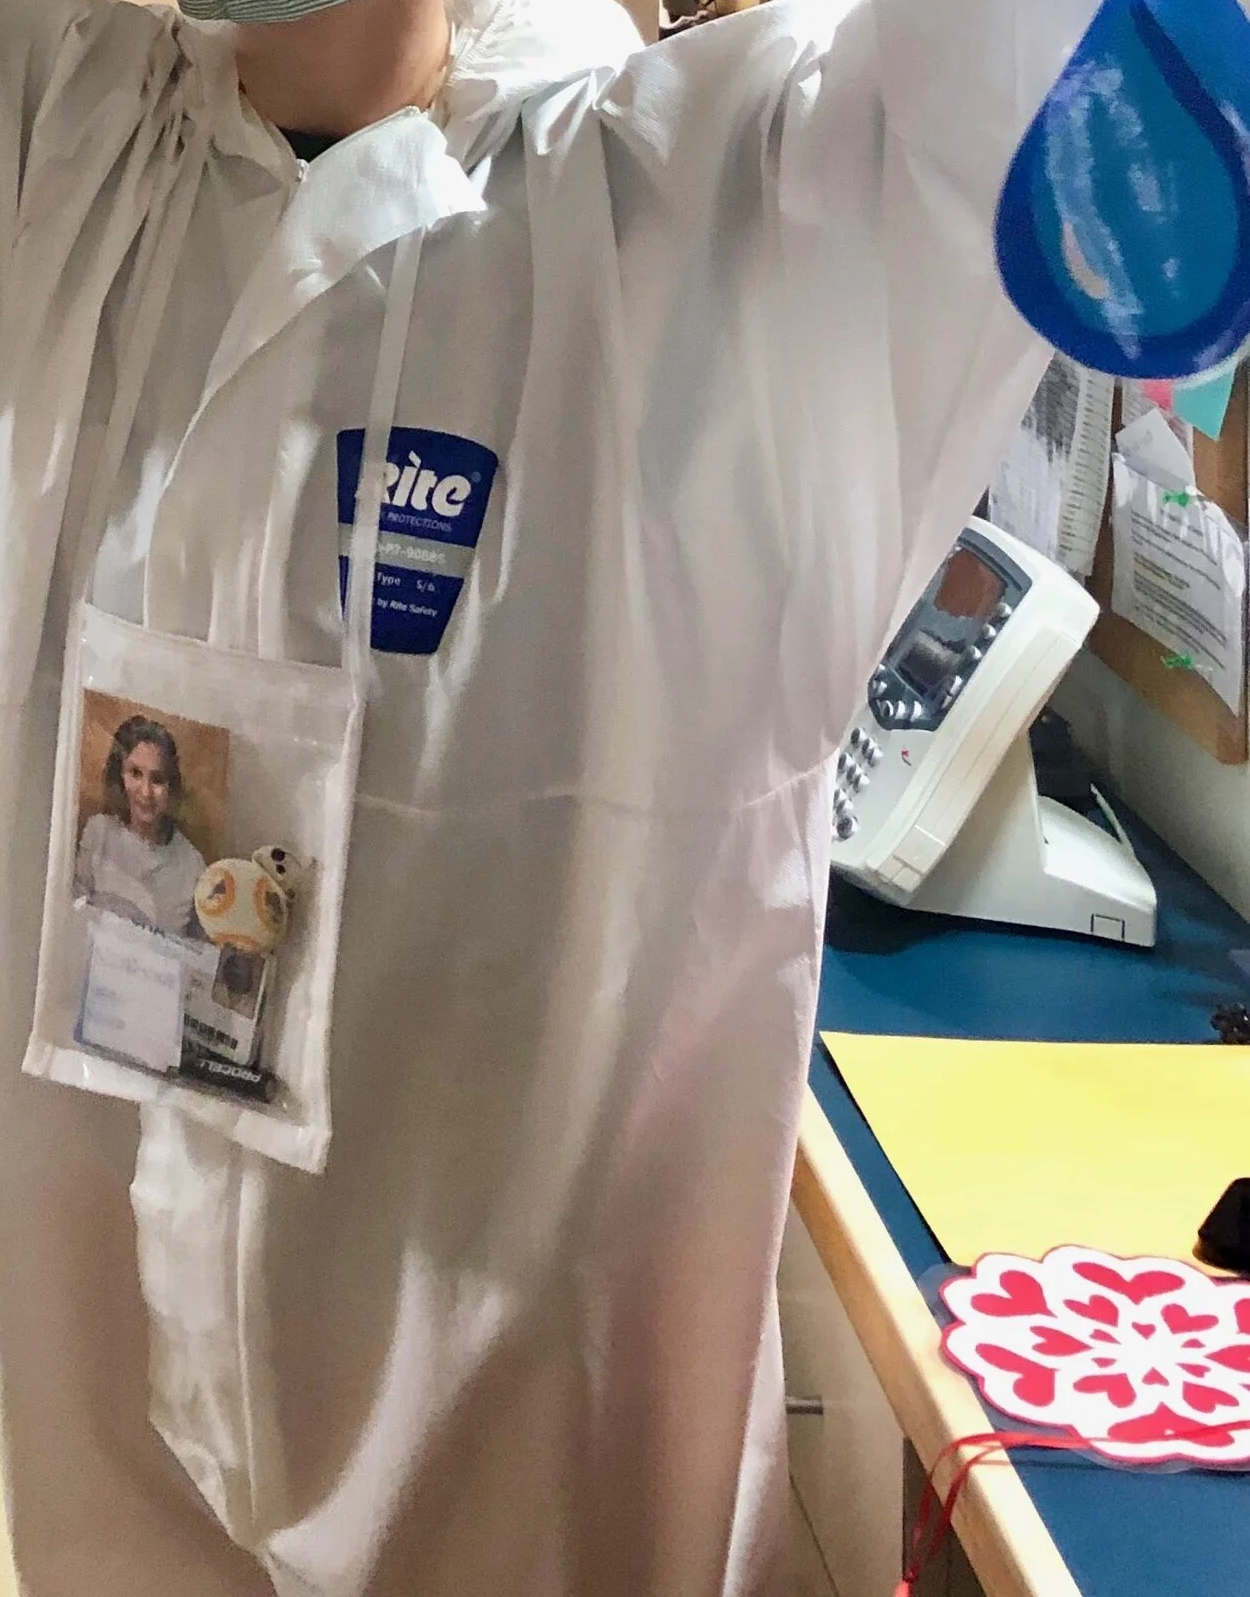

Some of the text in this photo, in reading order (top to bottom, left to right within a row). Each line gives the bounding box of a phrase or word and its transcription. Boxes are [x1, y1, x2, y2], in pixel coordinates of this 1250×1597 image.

[387, 511, 453, 533] PROTECTIONS
[389, 599, 407, 611] Rite
[409, 602, 438, 617] Safety
